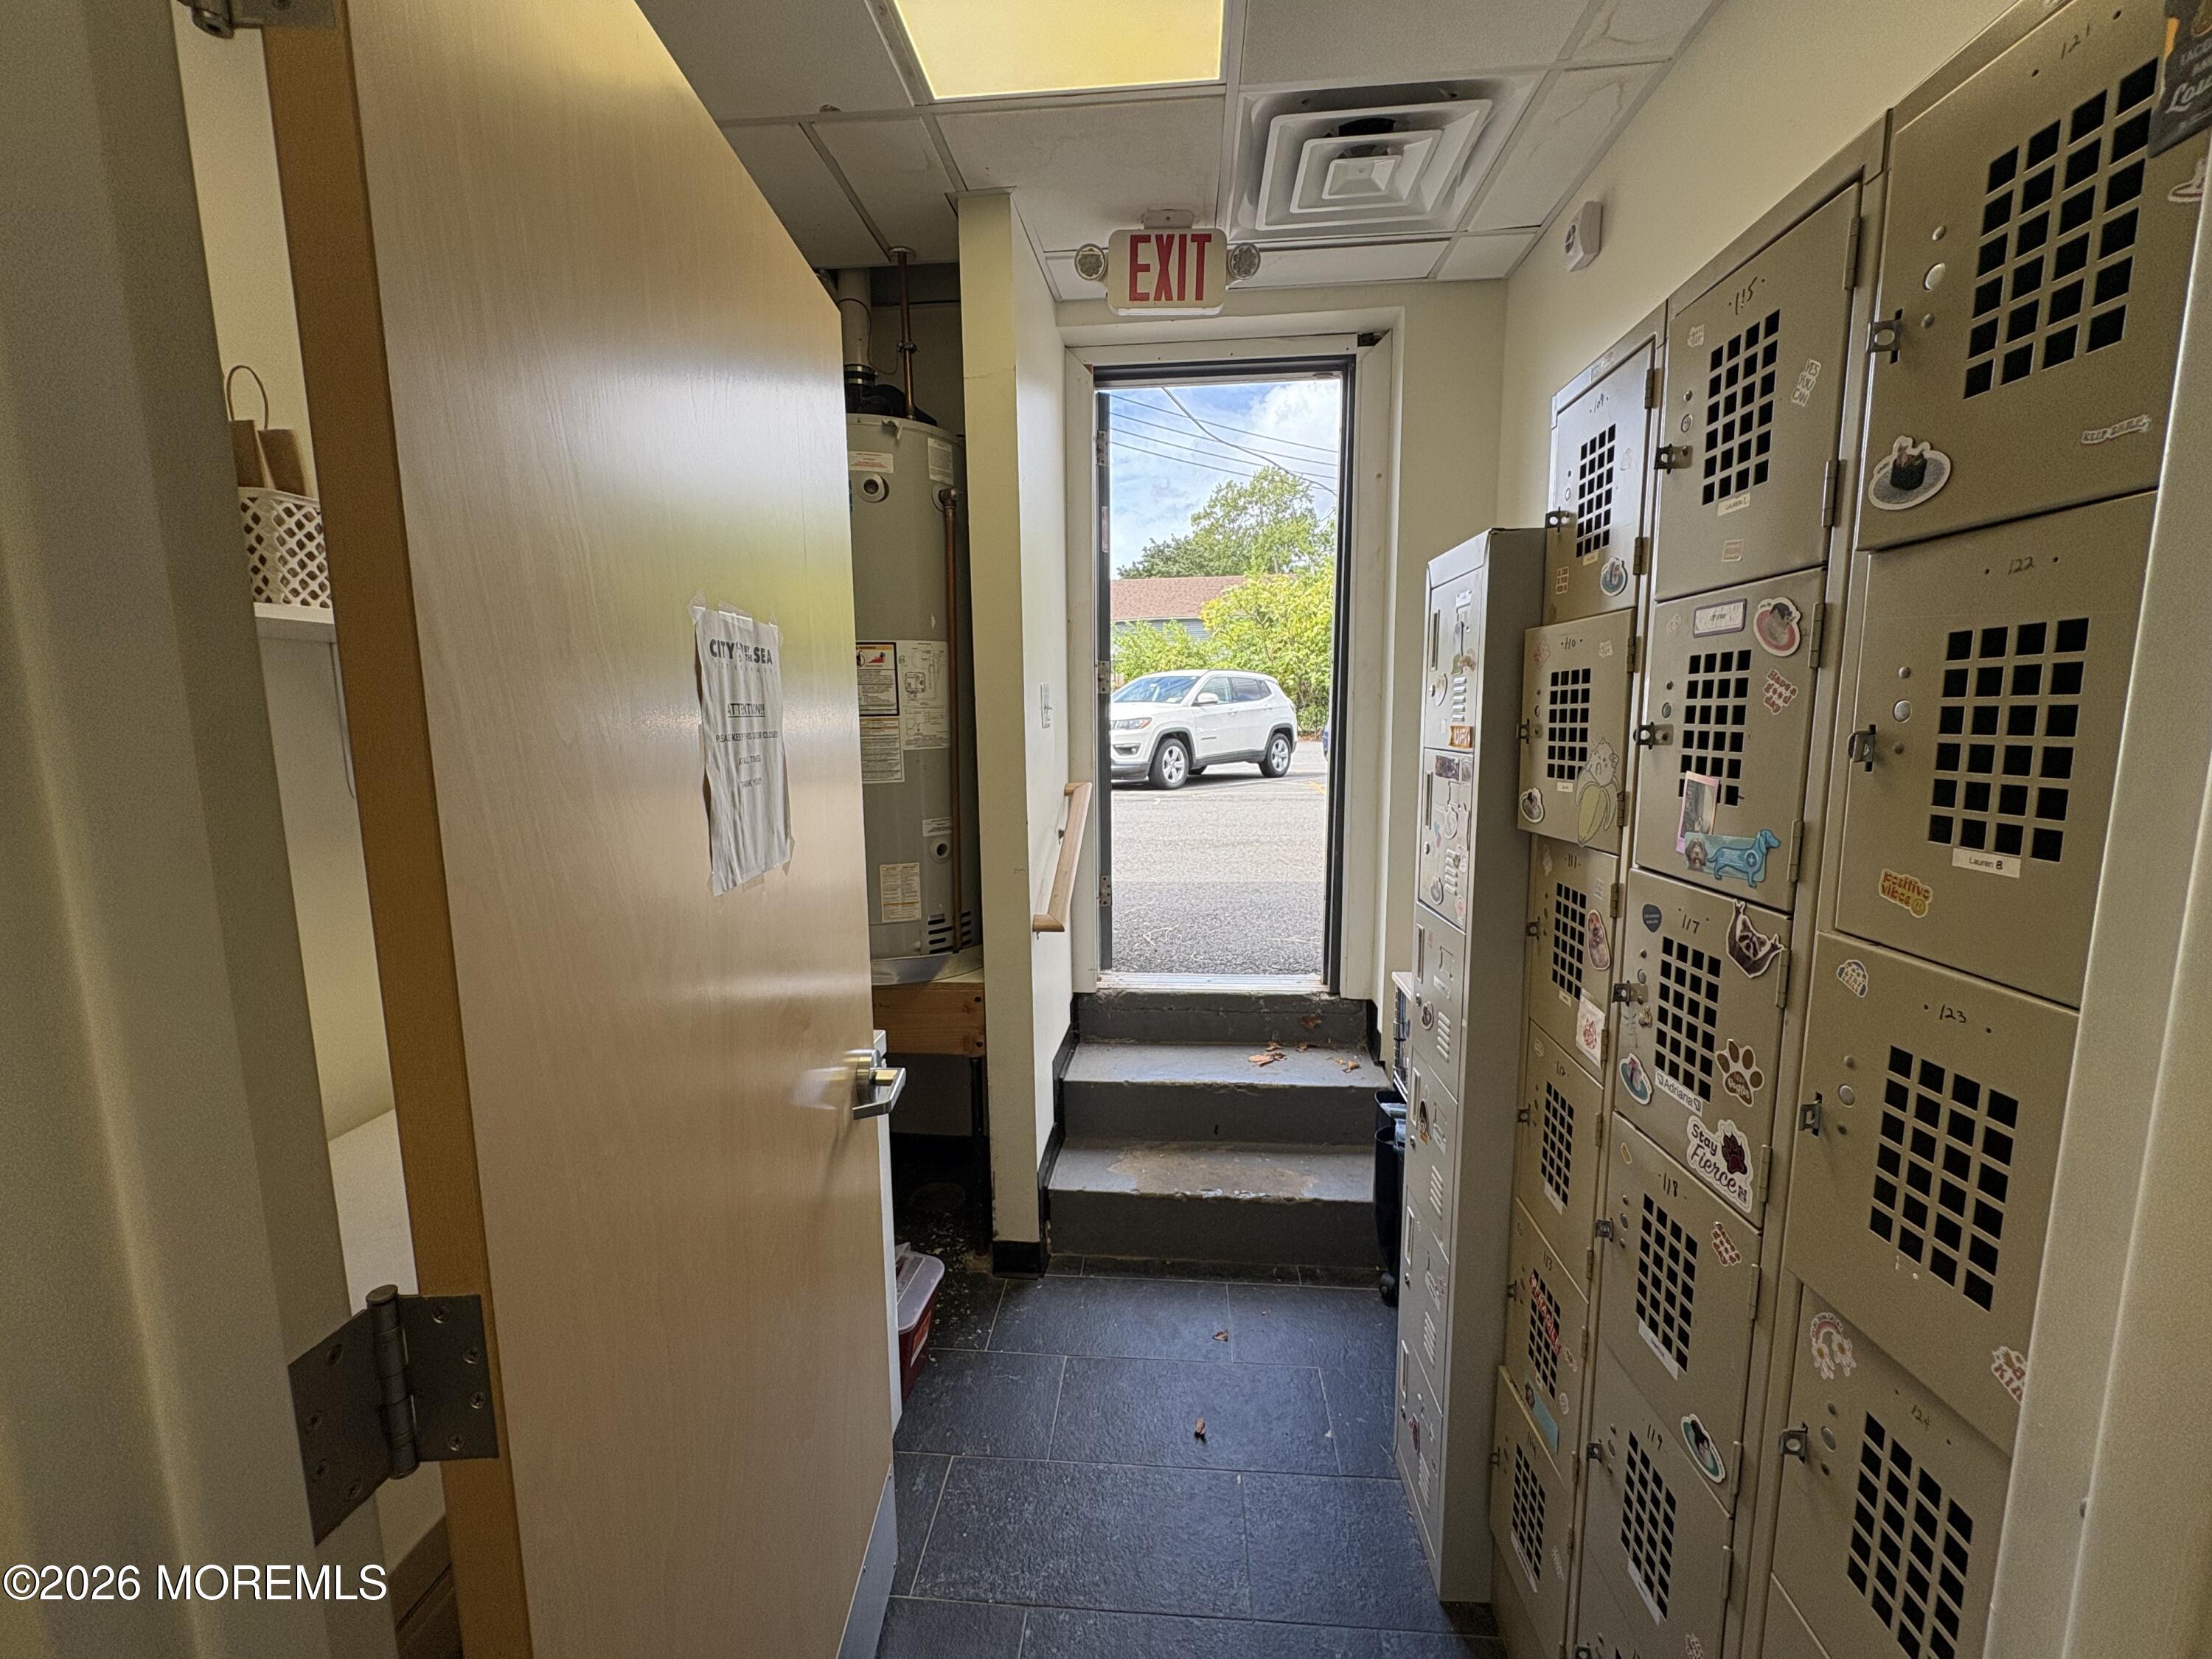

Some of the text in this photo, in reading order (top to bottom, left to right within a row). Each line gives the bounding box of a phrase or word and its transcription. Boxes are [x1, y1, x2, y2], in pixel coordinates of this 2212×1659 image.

[2061, 24, 2090, 60] 121
[1129, 233, 1212, 302] EXIT
[1735, 276, 1758, 316] 115
[2008, 556, 2035, 575] 122
[709, 639, 735, 660] CITY
[754, 646, 773, 665] SEA
[1969, 856, 1994, 869] Lauren
[1682, 914, 1700, 934] 117
[1938, 1004, 1967, 1023] 123
[1663, 1078, 1694, 1107] Adriana
[1691, 1123, 1718, 1156] Stay
[1691, 1143, 1737, 1194] Fierce
[1663, 1172, 1678, 1197] 118
[1910, 1405, 1930, 1429] 124
[1647, 1424, 1663, 1451] 119
